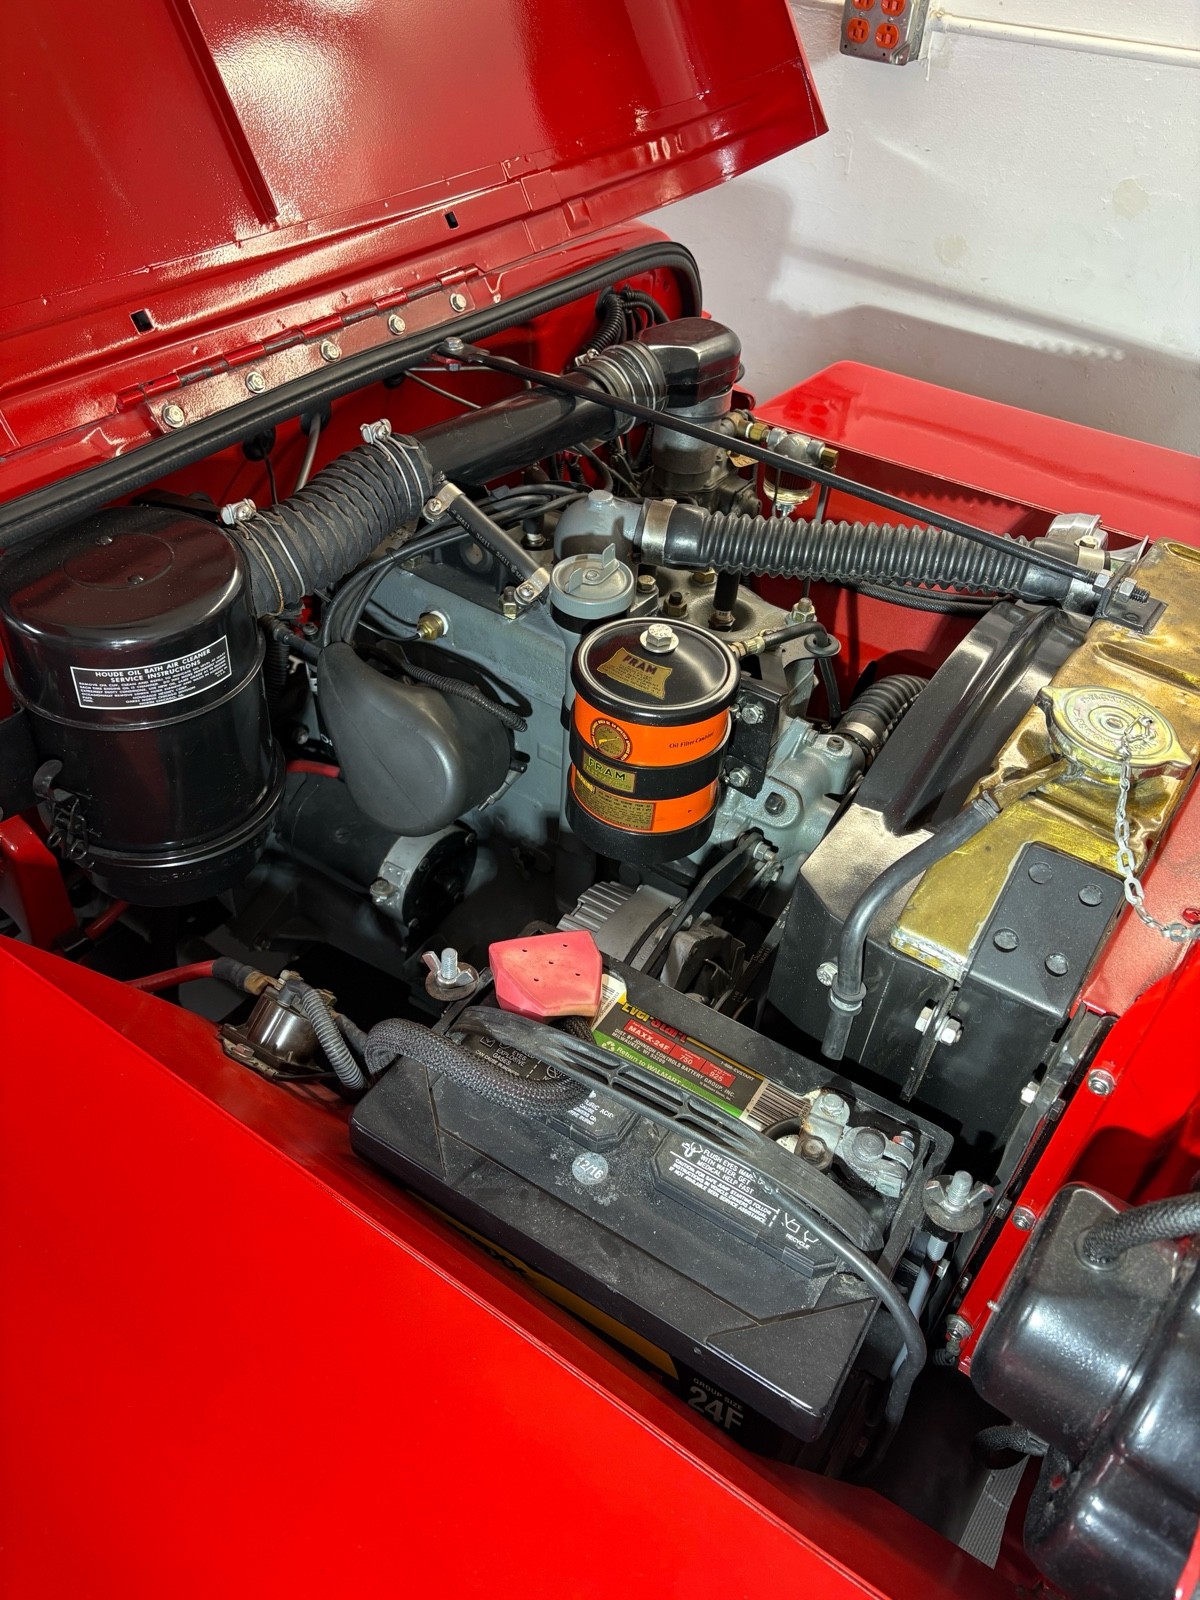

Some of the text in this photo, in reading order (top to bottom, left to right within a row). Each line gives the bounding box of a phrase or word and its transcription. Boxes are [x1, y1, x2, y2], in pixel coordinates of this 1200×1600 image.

[166, 661, 178, 669] AIR
[181, 648, 210, 665] CLEANER
[622, 654, 658, 675] FRAM
[111, 659, 200, 683] SERVICE INSTRUCTIONS
[680, 739, 695, 748] Filter
[588, 756, 626, 781] FRAM
[611, 1032, 640, 1050] MILWAUKEE,
[650, 1053, 665, 1063] 53209
[628, 1026, 669, 1050] MAXX-24F
[492, 1052, 510, 1066] GASES
[496, 1047, 524, 1067] EXPLOSIVE
[512, 1050, 526, 1061] EYES
[616, 1047, 682, 1085] Return to WALMART
[679, 1055, 692, 1064] 750
[634, 1039, 655, 1052] JOHNSON
[656, 1052, 680, 1066] CONTROLS
[681, 1065, 703, 1079] BATTERY
[704, 1078, 723, 1091] GROUP,
[724, 1089, 734, 1097] INC.
[709, 1071, 722, 1081] 925
[600, 1108, 613, 1118] ACID
[576, 1157, 604, 1179] 12/16
[700, 1154, 715, 1166] WITH
[738, 1175, 749, 1184] GET
[703, 1149, 722, 1162] FLUSH
[723, 1160, 737, 1171] EYES
[672, 1163, 704, 1183] INSTRUCTIONS
[710, 1184, 727, 1196] VEHICLE
[674, 1169, 683, 1177] NOT
[697, 1160, 753, 1194] MEDICAL HELP FAST
[705, 1176, 716, 1184] SAFE
[717, 1182, 729, 1191] JUMP
[730, 1190, 751, 1204] STARTING
[752, 1202, 771, 1215] FOLLOW
[785, 1233, 809, 1249] RECYCLE
[693, 1378, 744, 1411] GROUP SIZE
[688, 1386, 743, 1429] 24F
